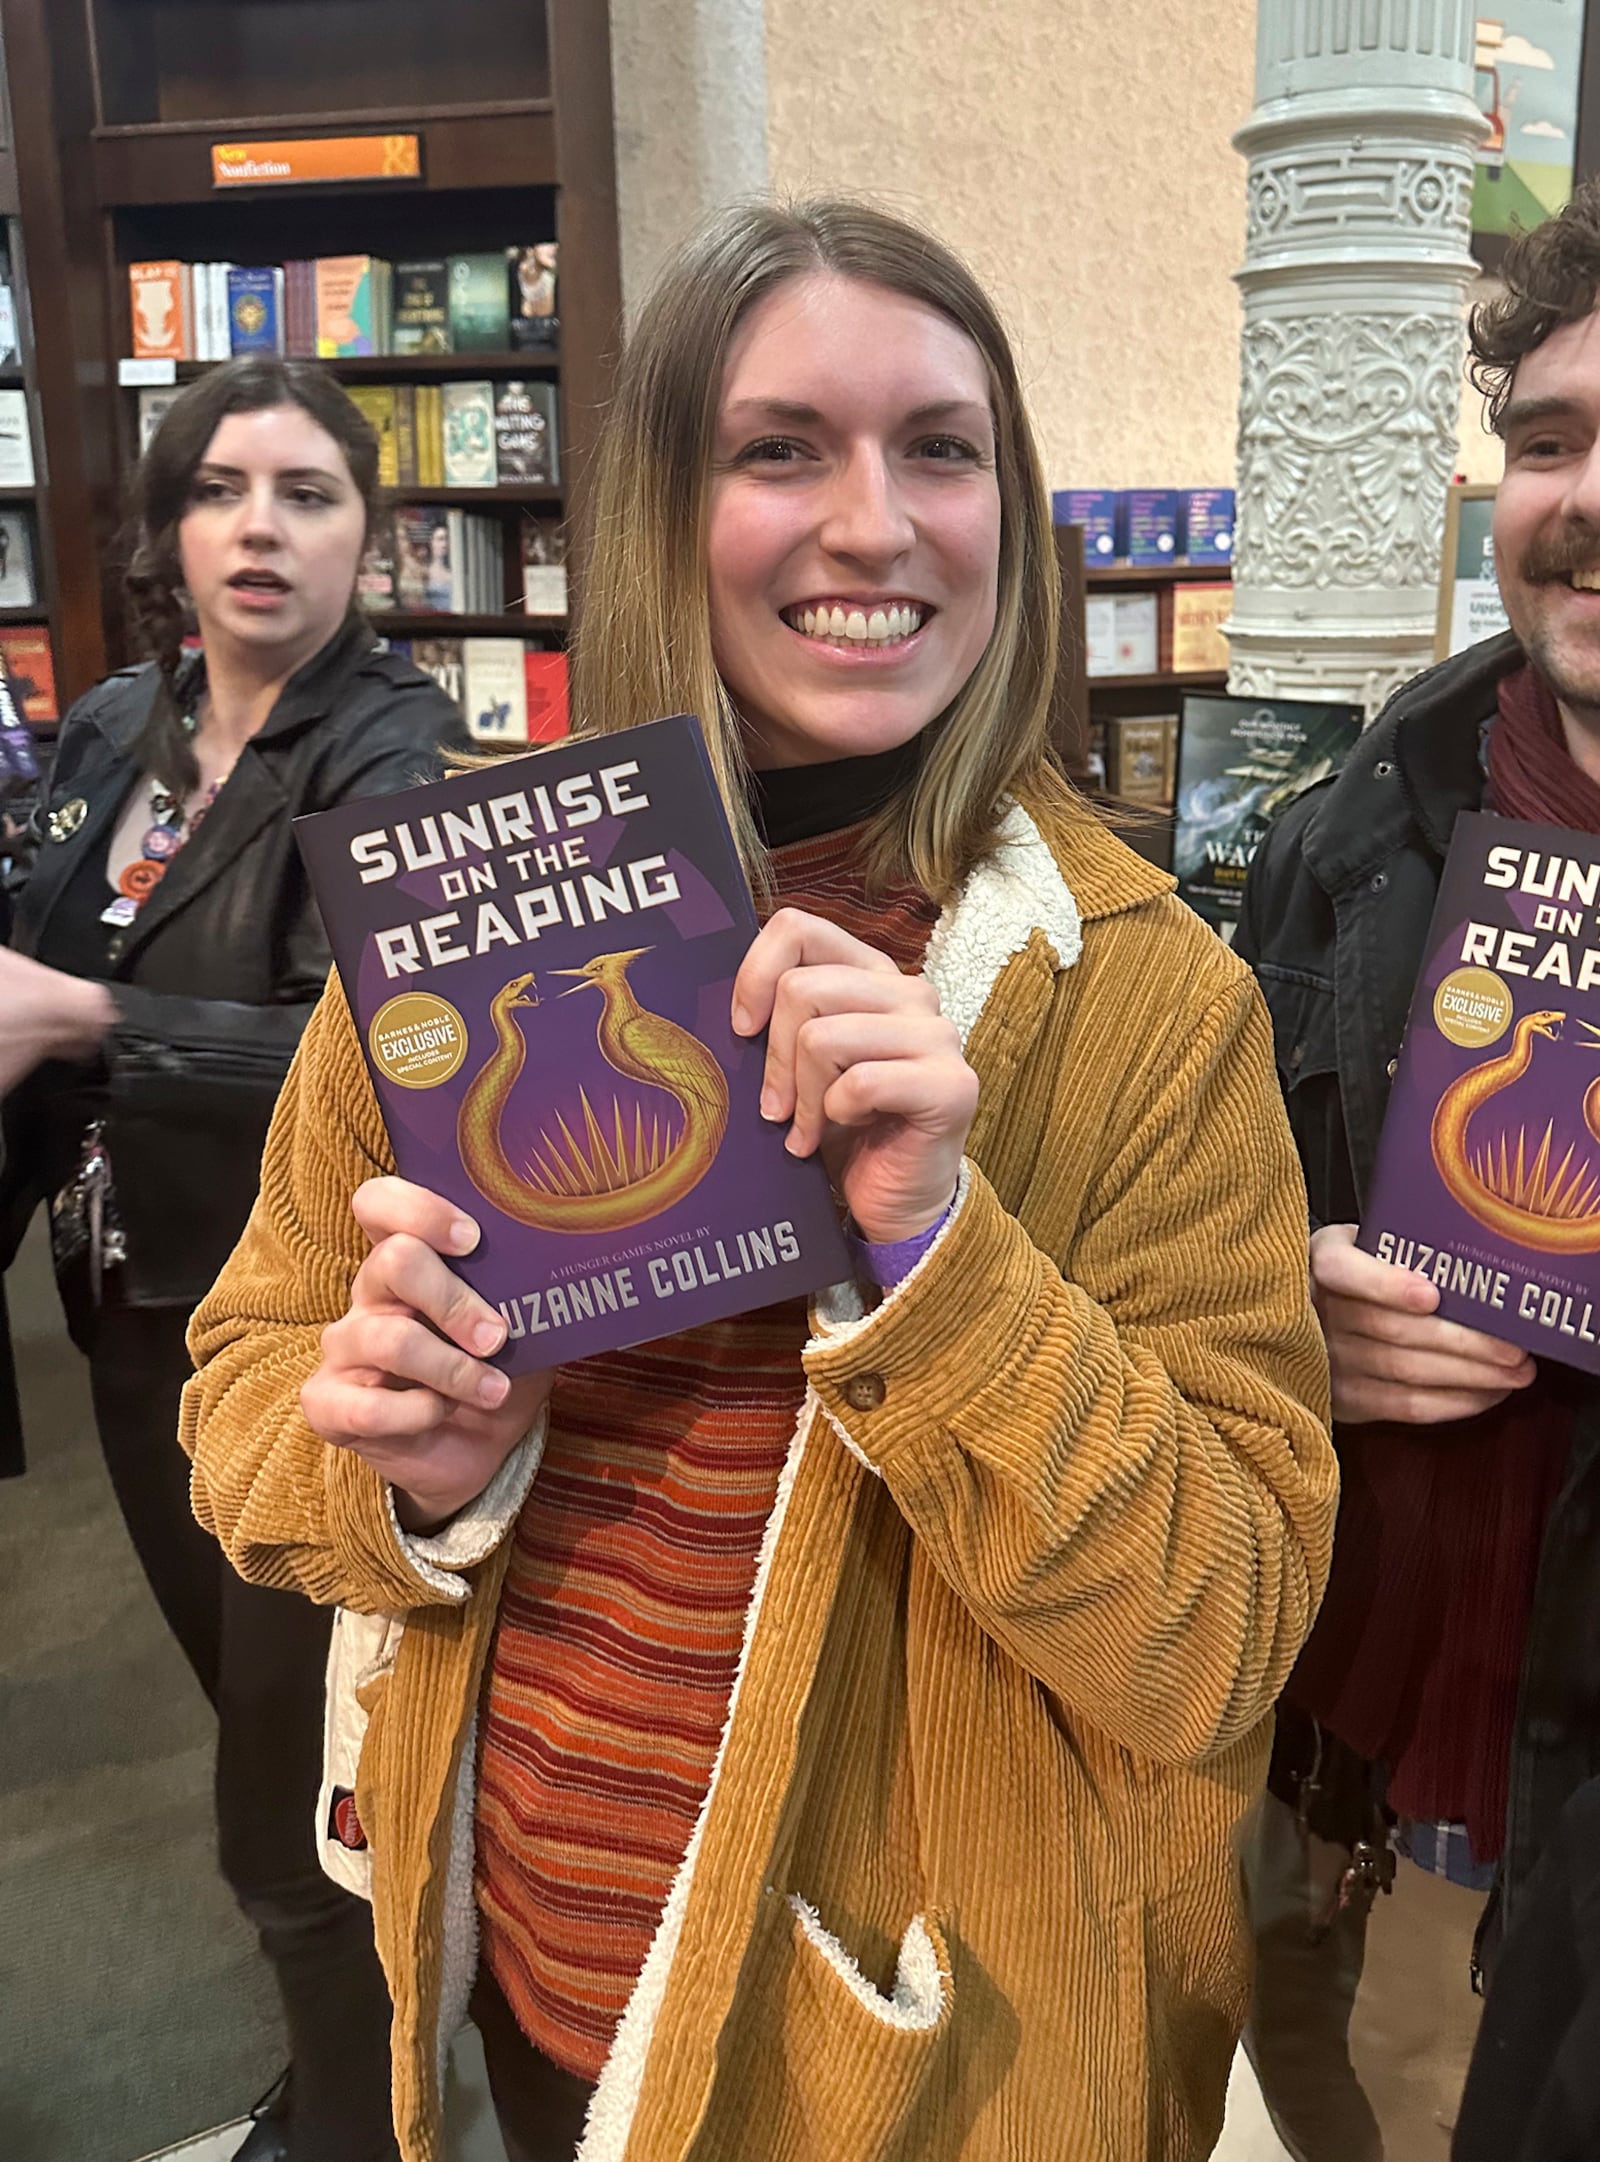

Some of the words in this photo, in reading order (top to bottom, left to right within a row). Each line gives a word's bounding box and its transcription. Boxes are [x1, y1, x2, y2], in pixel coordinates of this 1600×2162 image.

[218, 161, 291, 177] Nonfiction
[350, 760, 651, 884] SUNRISE
[440, 861, 498, 902] ON
[506, 836, 591, 881] THE
[1483, 846, 1600, 907] SUN
[374, 854, 681, 979] REAPING
[1533, 903, 1584, 937] ON
[378, 1025, 413, 1042] BARNES
[414, 1023, 421, 1031] &
[420, 1014, 451, 1030] NOBLE
[1442, 993, 1504, 1024] EXCLUSIVE
[381, 1023, 457, 1061] EXCLUSIVE
[397, 1062, 423, 1074] SPECIAL
[423, 1052, 453, 1066] CONTENT
[407, 1049, 440, 1064] INCLUDES
[550, 1269, 558, 1281] A
[560, 1255, 611, 1277] HUNGER
[612, 1244, 654, 1263] GAMES
[654, 1233, 695, 1253] NOVEL
[696, 1225, 712, 1240] BY
[499, 1267, 640, 1340] UZANNE
[648, 1220, 801, 1299] COLLINS
[1376, 1231, 1511, 1310] SUZANNE
[1518, 1281, 1600, 1345] COLL
